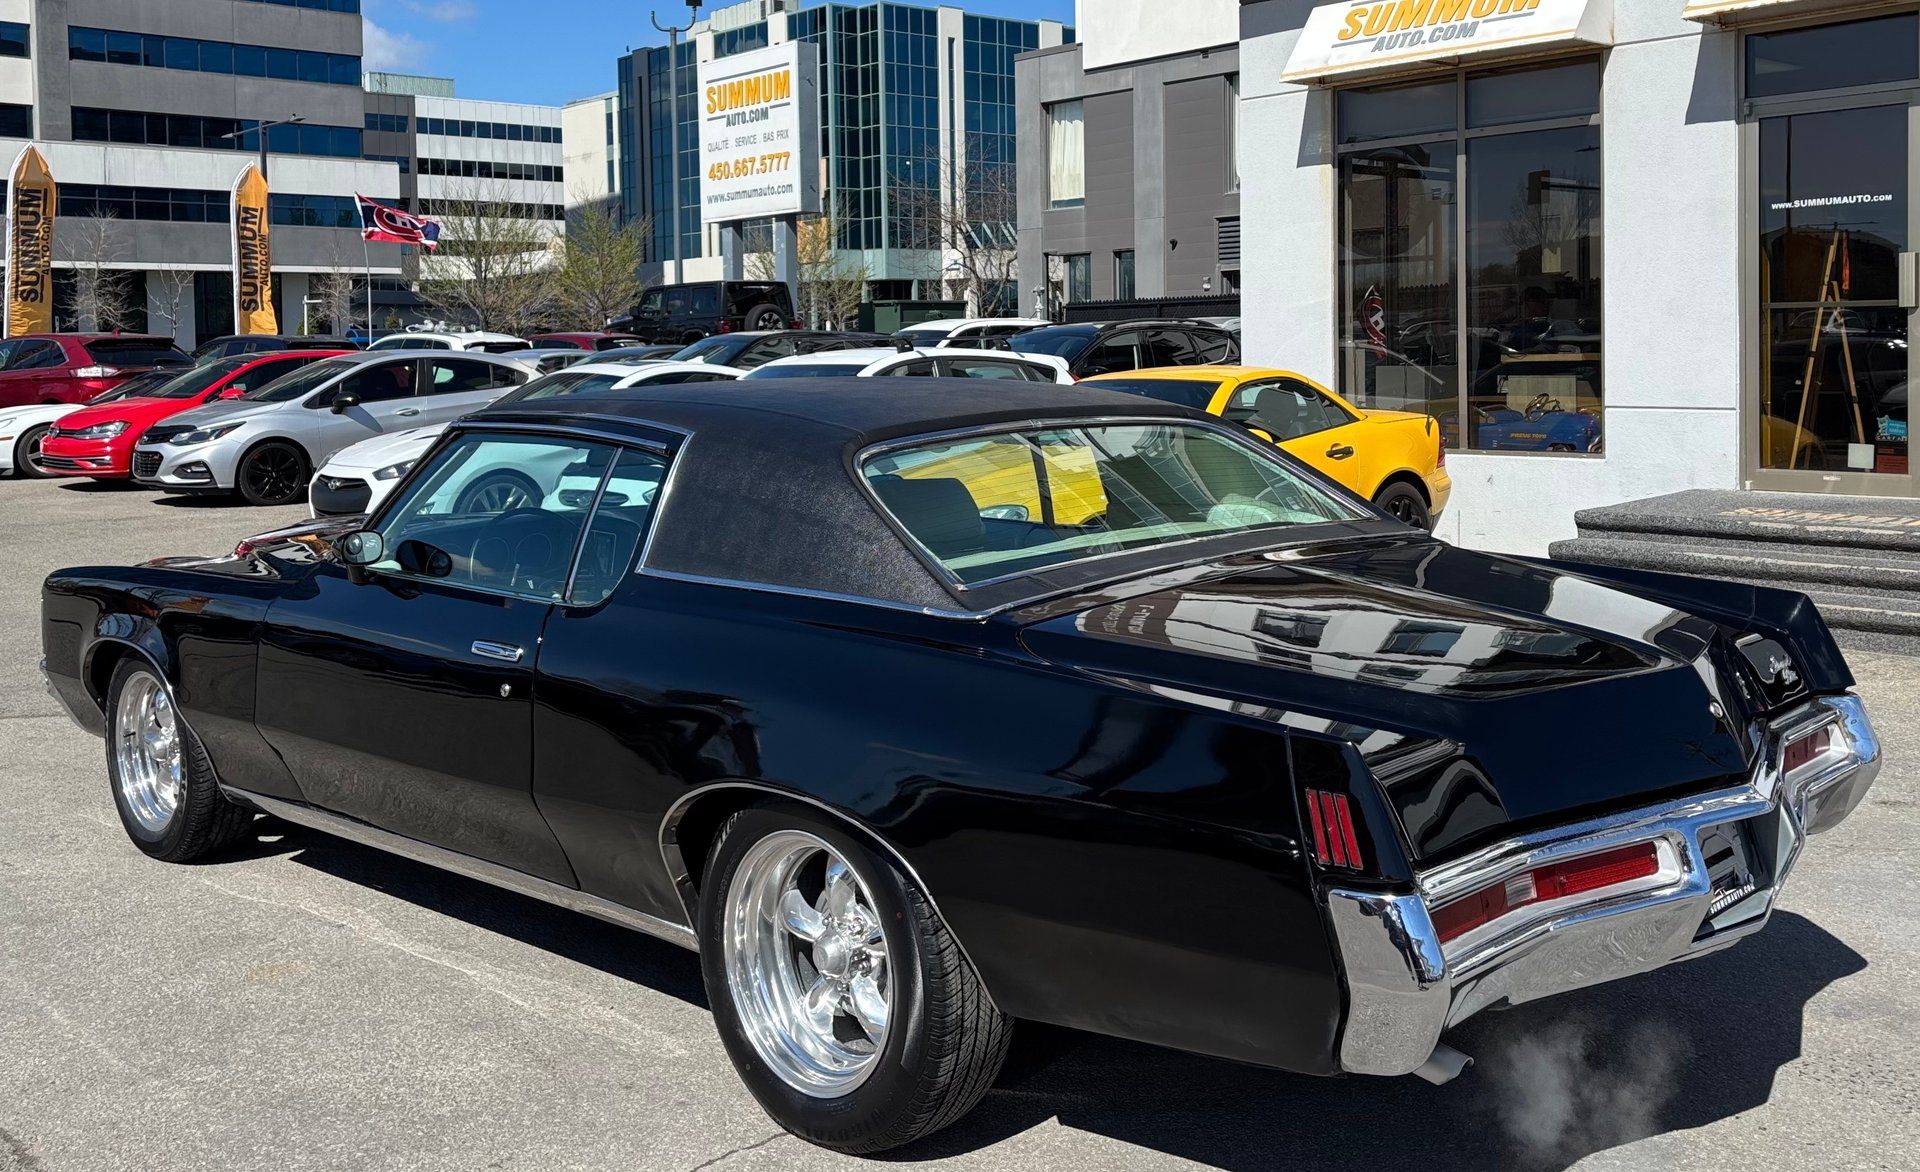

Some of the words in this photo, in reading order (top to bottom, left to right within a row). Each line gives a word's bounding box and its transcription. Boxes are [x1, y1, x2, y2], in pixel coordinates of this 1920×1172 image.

[1371, 21, 1480, 53] AUTO.COM
[706, 69, 790, 114] SUMMUM
[725, 106, 770, 128] AUTO.COM
[735, 134, 757, 147] SERVICE
[763, 131, 774, 142] BAS
[776, 128, 789, 140] PRIX
[707, 151, 790, 182] 450.667.5777
[706, 182, 794, 204] www.summumauto.com
[19, 187, 42, 303] SUMMUM
[42, 216, 52, 275] AUTO.COM
[241, 206, 259, 312] SUMMUM
[259, 234, 269, 286] AUTO.COM
